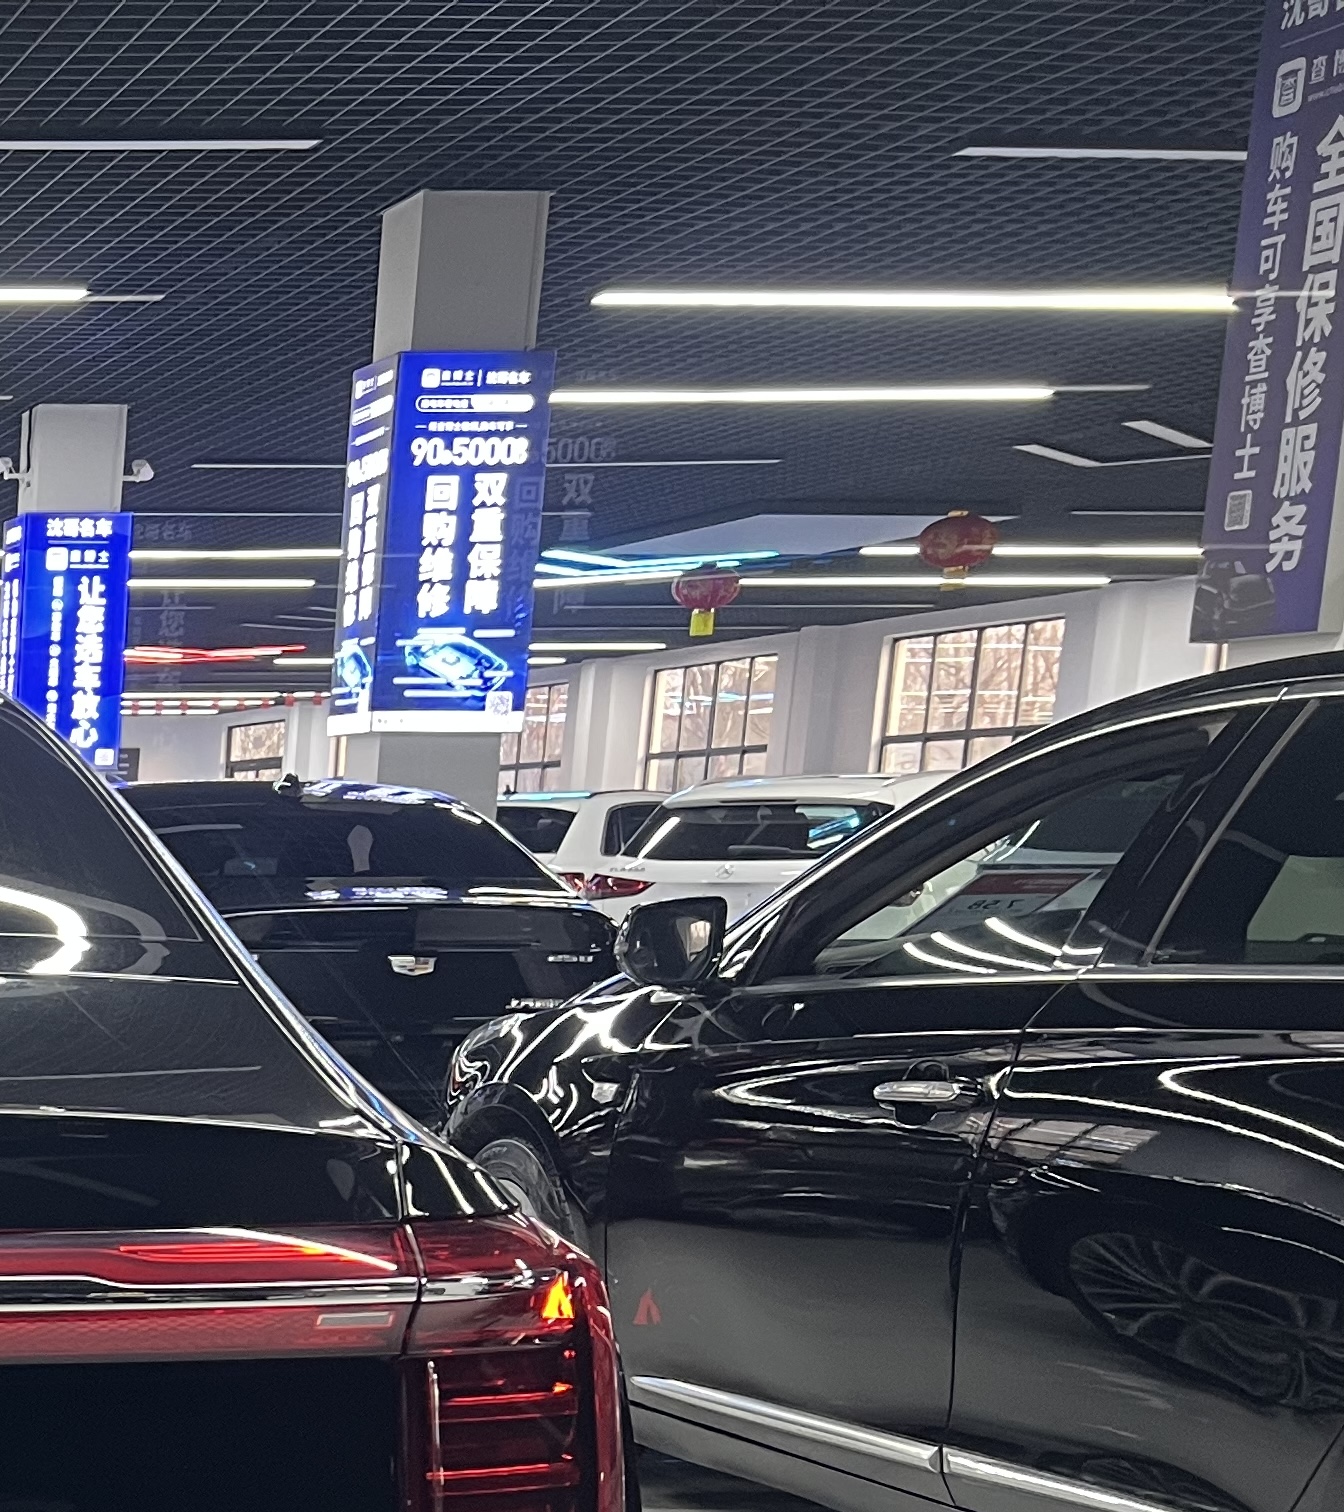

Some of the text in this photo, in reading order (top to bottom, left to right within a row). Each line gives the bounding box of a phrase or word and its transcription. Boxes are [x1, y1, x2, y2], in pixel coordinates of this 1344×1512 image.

[1233, 131, 1299, 479] 购车可享查博士
[416, 474, 460, 619] 回购维修
[463, 472, 509, 615] 双重保障
